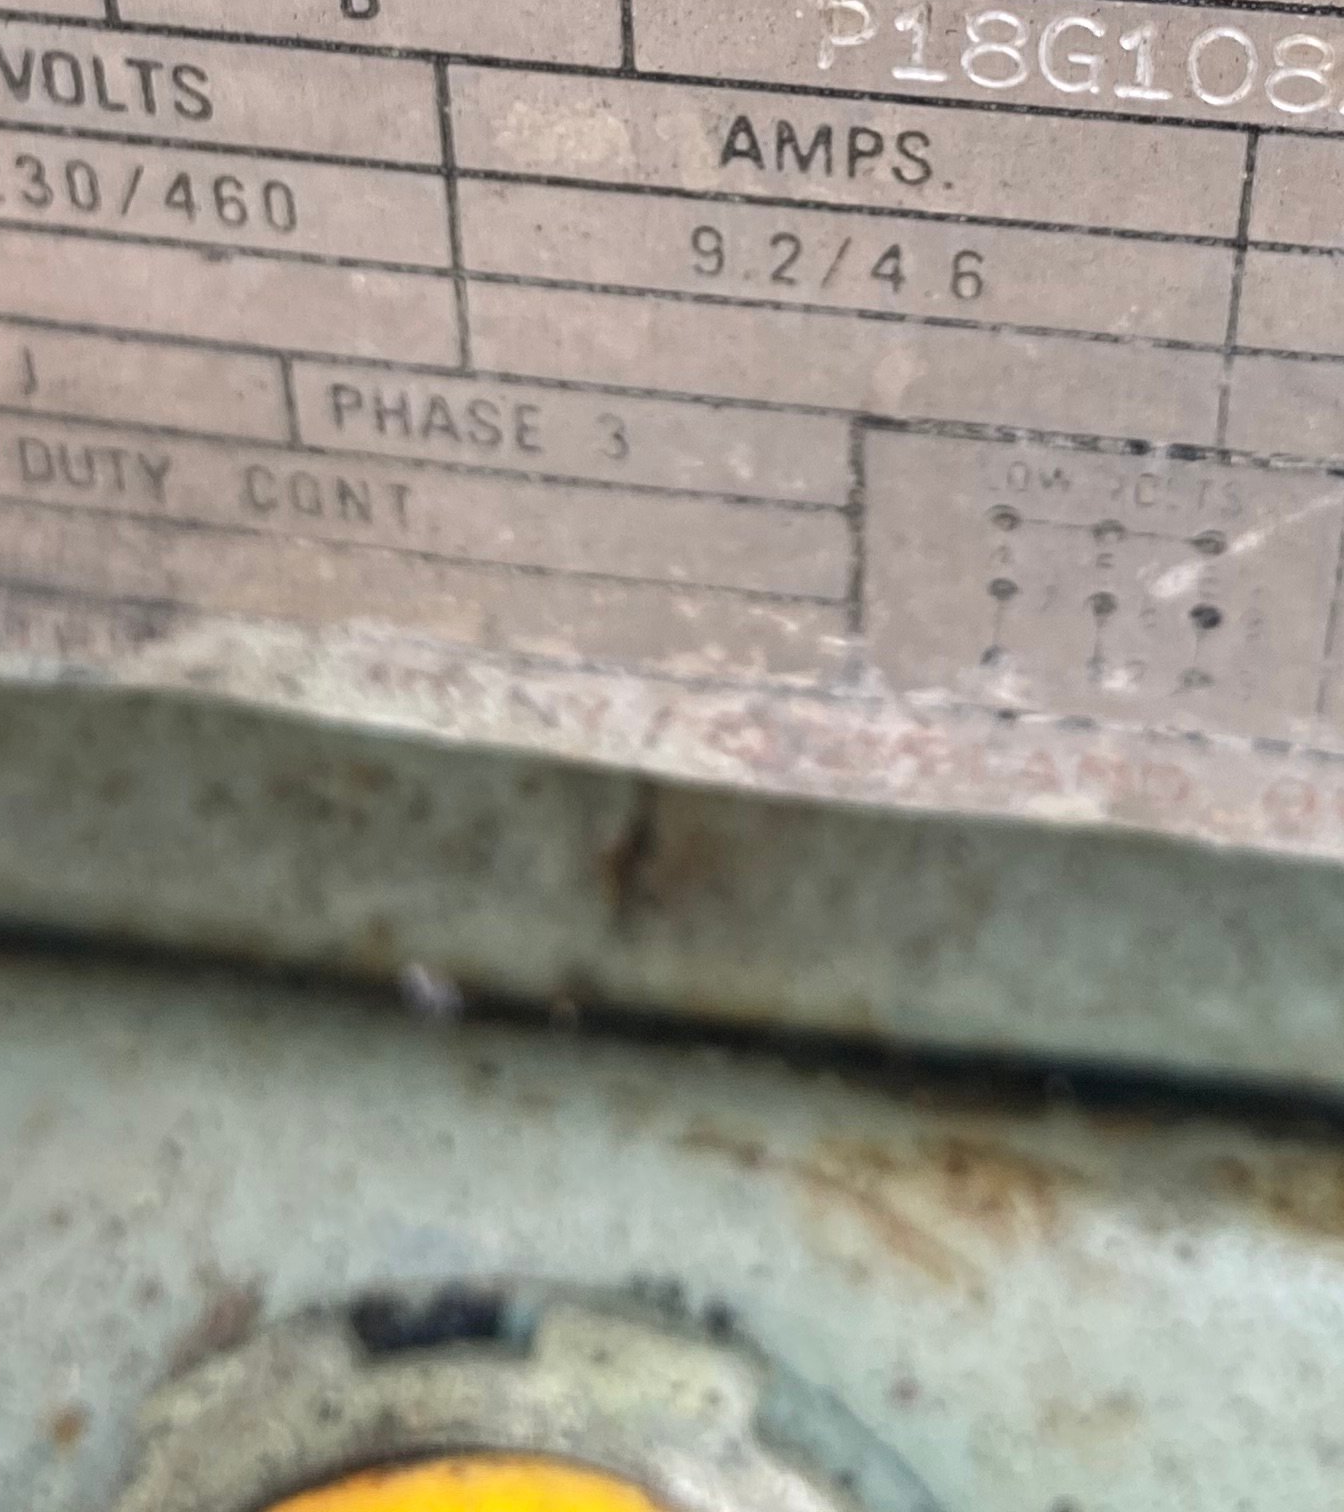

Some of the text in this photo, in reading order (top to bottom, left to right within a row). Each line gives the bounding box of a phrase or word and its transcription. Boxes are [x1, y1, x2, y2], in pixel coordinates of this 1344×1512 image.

[717, 113, 957, 192] AMPS.
[327, 380, 632, 461] PHASE 3
[16, 435, 176, 502] DUTY
